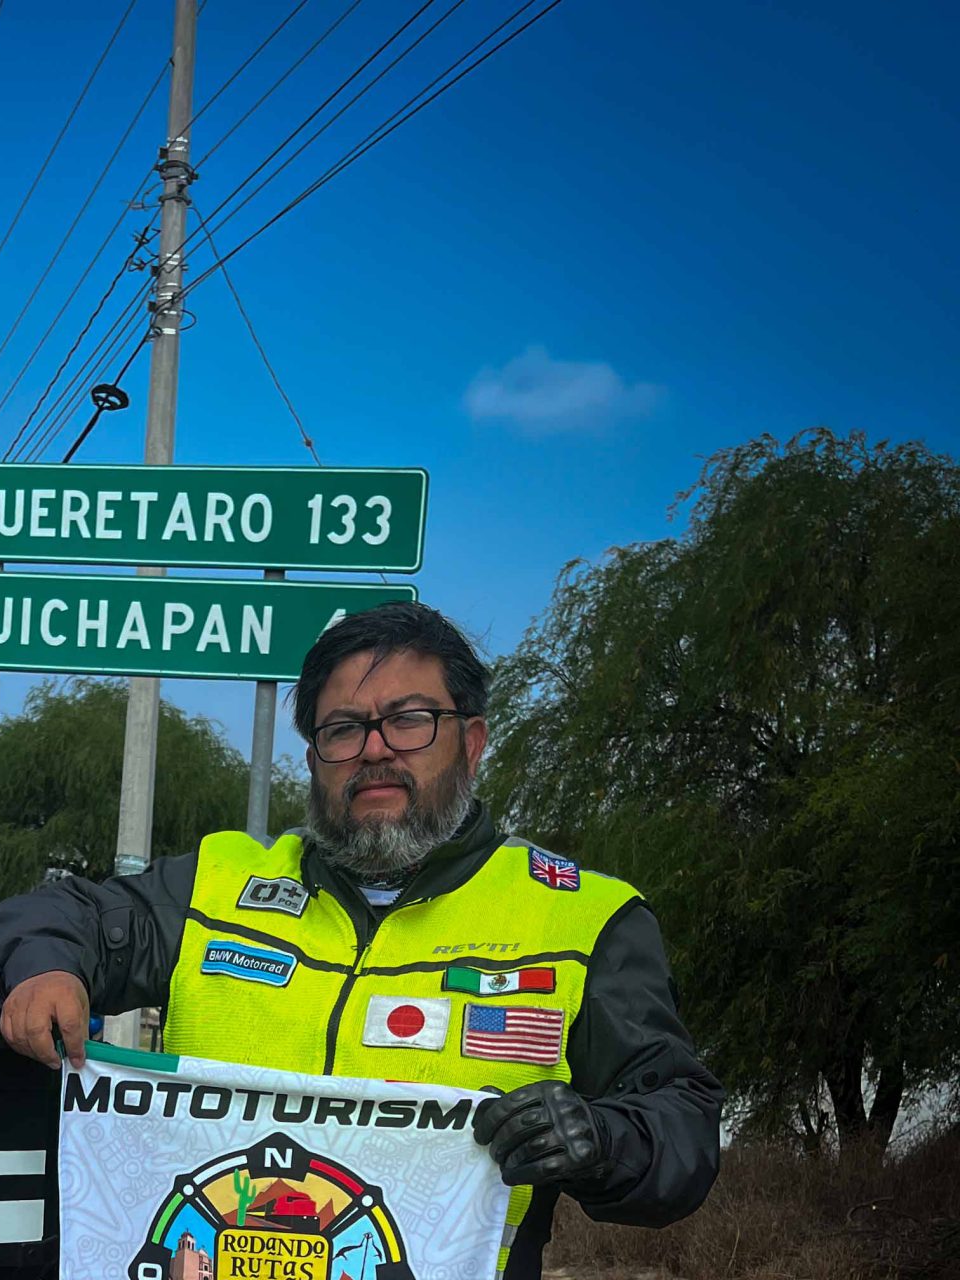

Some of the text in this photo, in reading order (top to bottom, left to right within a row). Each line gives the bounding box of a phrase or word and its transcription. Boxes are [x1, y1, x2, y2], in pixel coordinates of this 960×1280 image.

[307, 493, 392, 545] 133
[277, 897, 299, 909] POS
[208, 950, 285, 974] BMW Motorrad
[64, 1073, 492, 1130] MOTOTURISM
[264, 1147, 293, 1168] N
